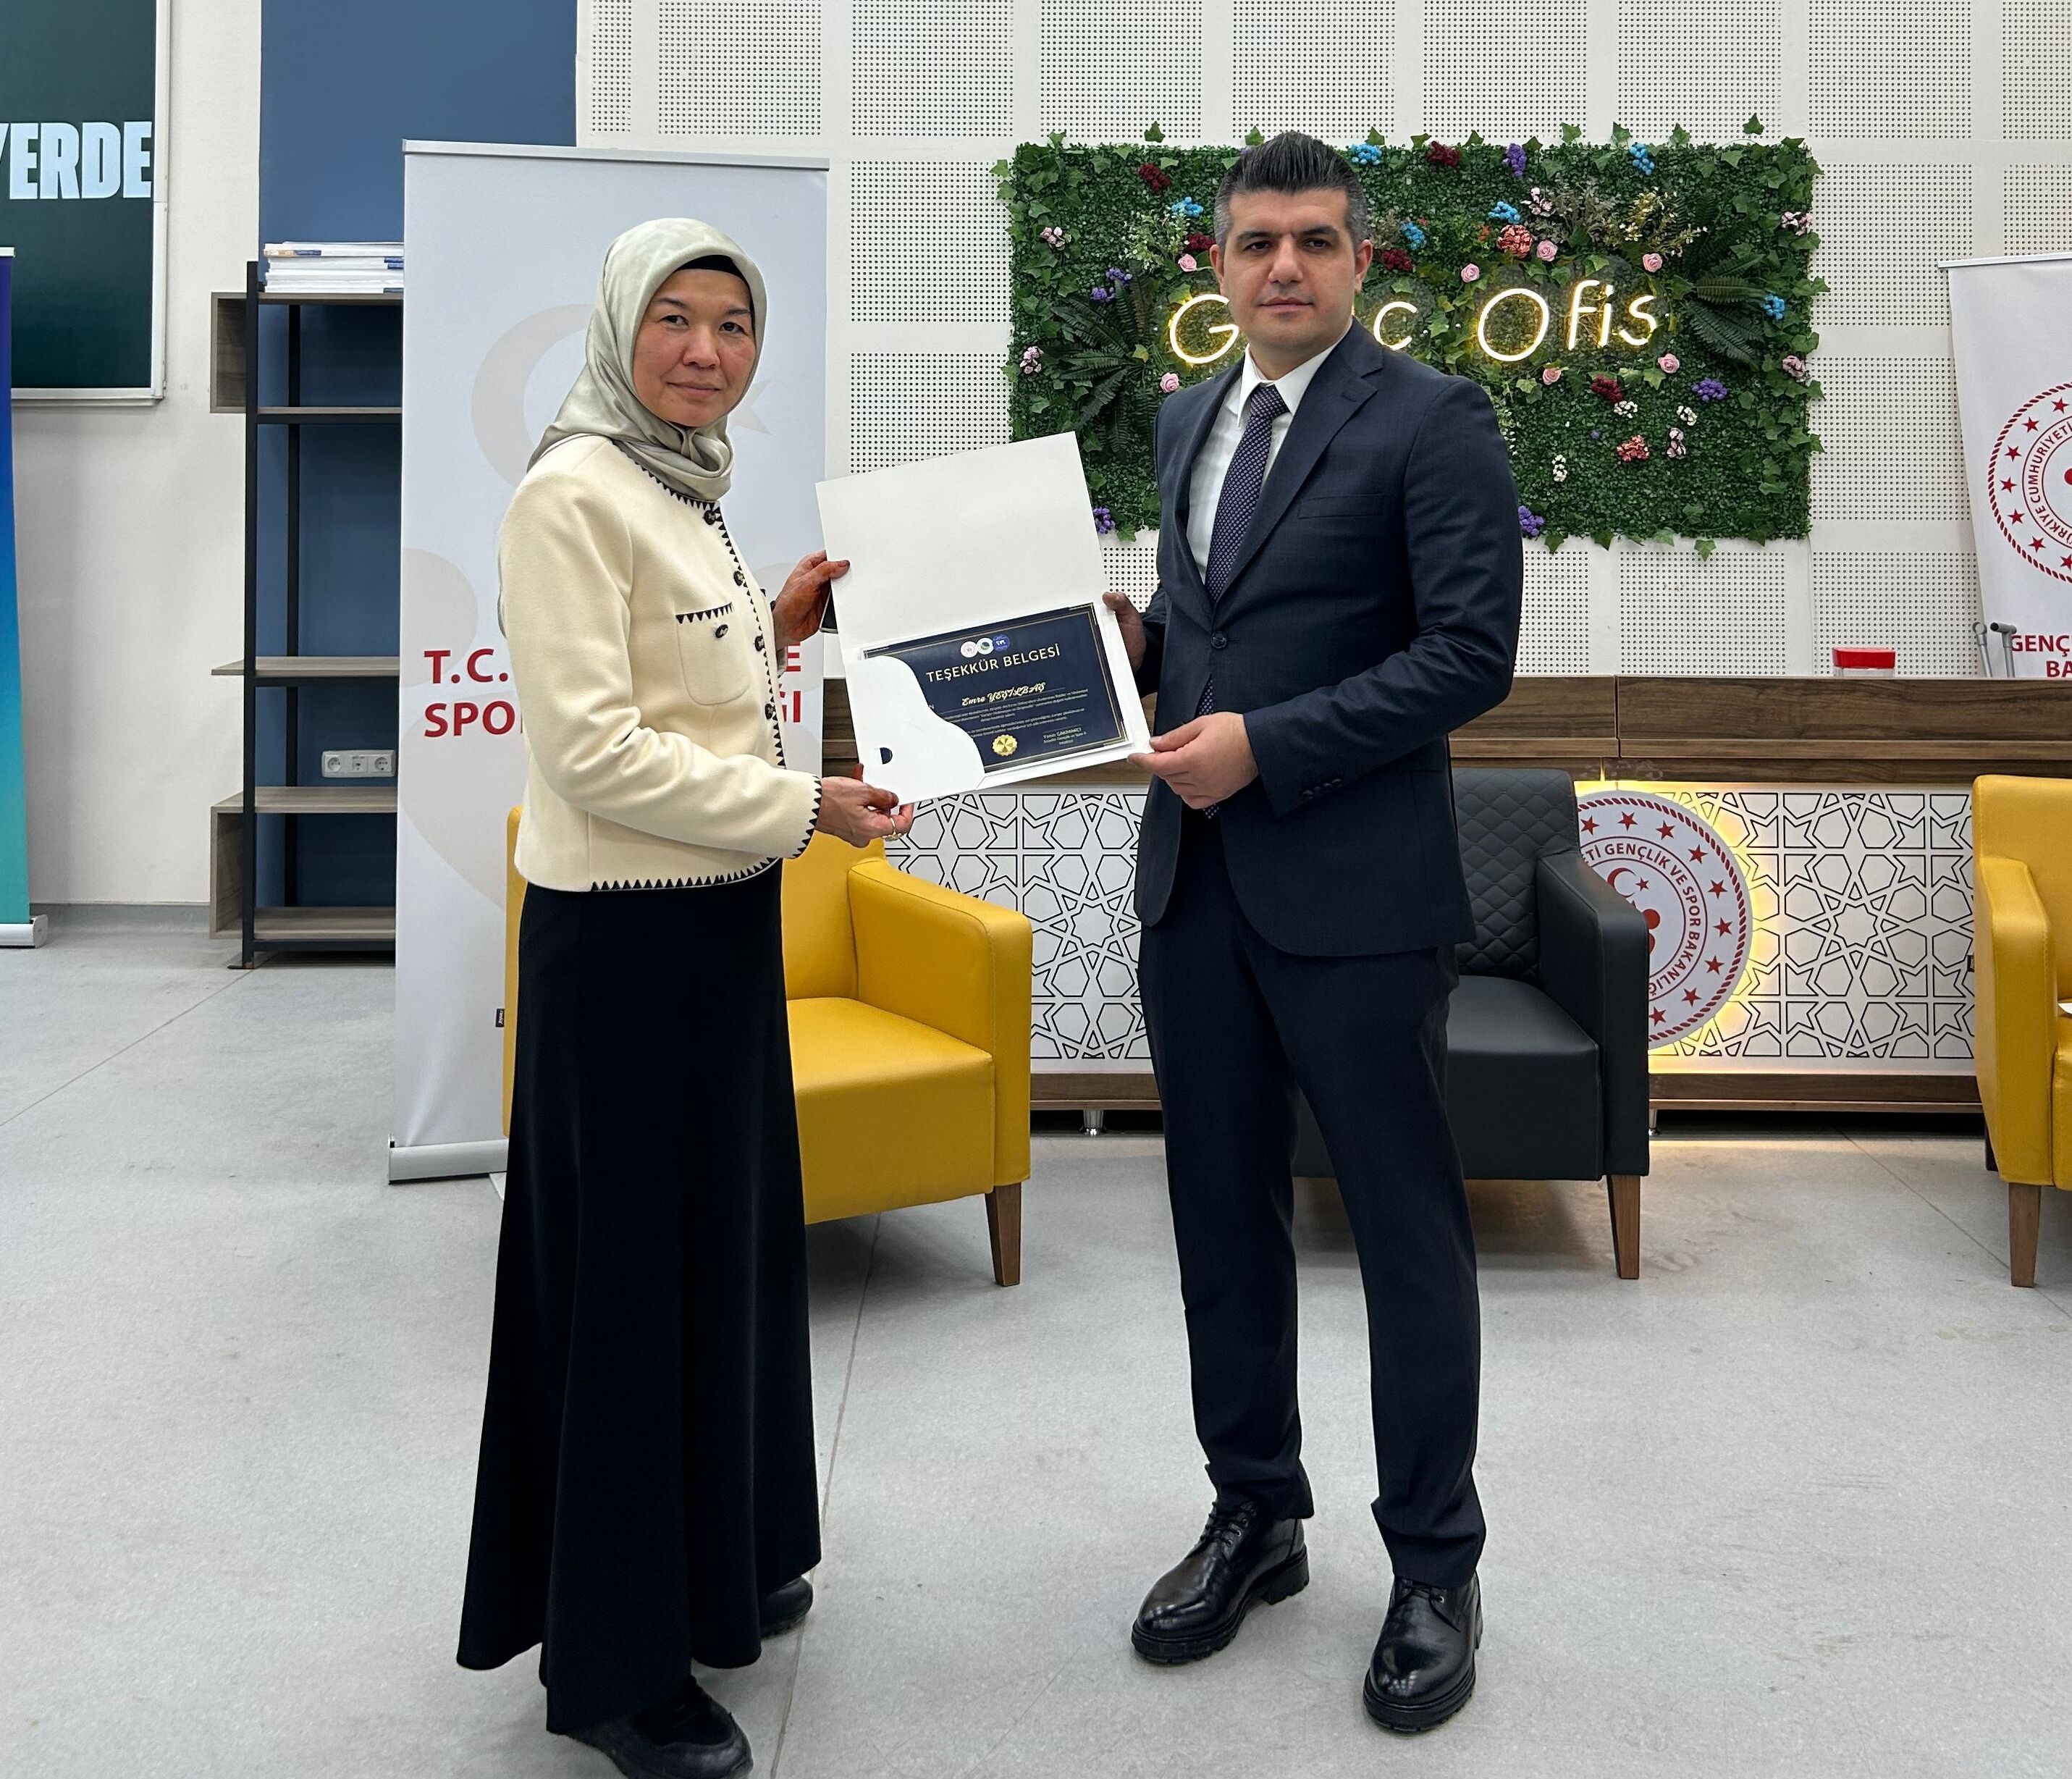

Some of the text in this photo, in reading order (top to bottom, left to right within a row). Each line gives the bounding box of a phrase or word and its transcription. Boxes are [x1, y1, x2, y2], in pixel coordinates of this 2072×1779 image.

[1478, 279, 1656, 361] Ofis
[925, 658, 999, 683] TEŞEKKÜR
[1003, 642, 1061, 667] BELGESİ
[2011, 634, 2072, 657] GENÇ
[424, 648, 509, 684] T.C.
[424, 700, 523, 738] SPO
[1604, 843, 1671, 870] GENÇLİK
[1669, 864, 1688, 886] VE
[1683, 886, 1701, 927] SPOR
[1648, 930, 1701, 996] BAKANLIĞ
